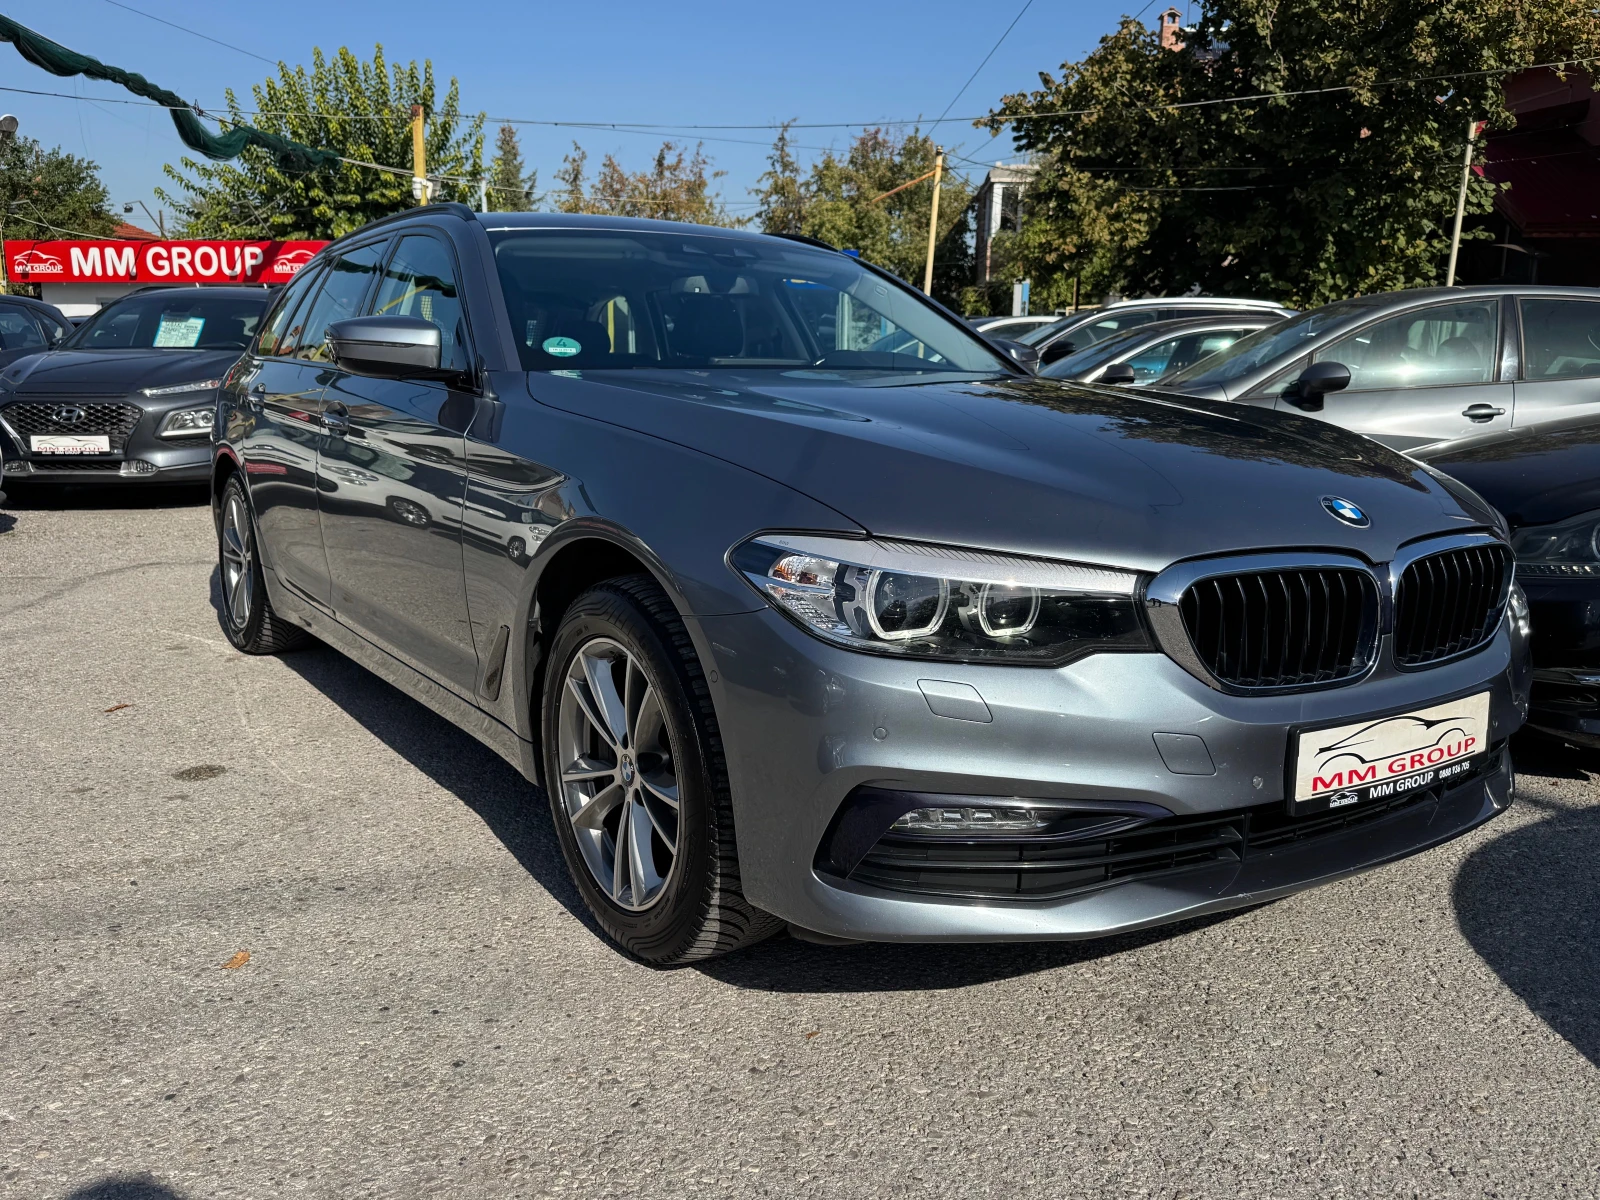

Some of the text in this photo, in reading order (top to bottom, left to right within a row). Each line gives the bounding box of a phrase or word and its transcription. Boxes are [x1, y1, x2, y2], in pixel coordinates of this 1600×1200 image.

[14, 264, 64, 272] MM GROUP
[70, 245, 264, 277] MM GROUP
[273, 264, 291, 272] MM
[556, 338, 568, 347] 4
[1312, 737, 1476, 792] MM GROUP
[1369, 782, 1394, 799] MM
[1396, 771, 1434, 792] GROUP
